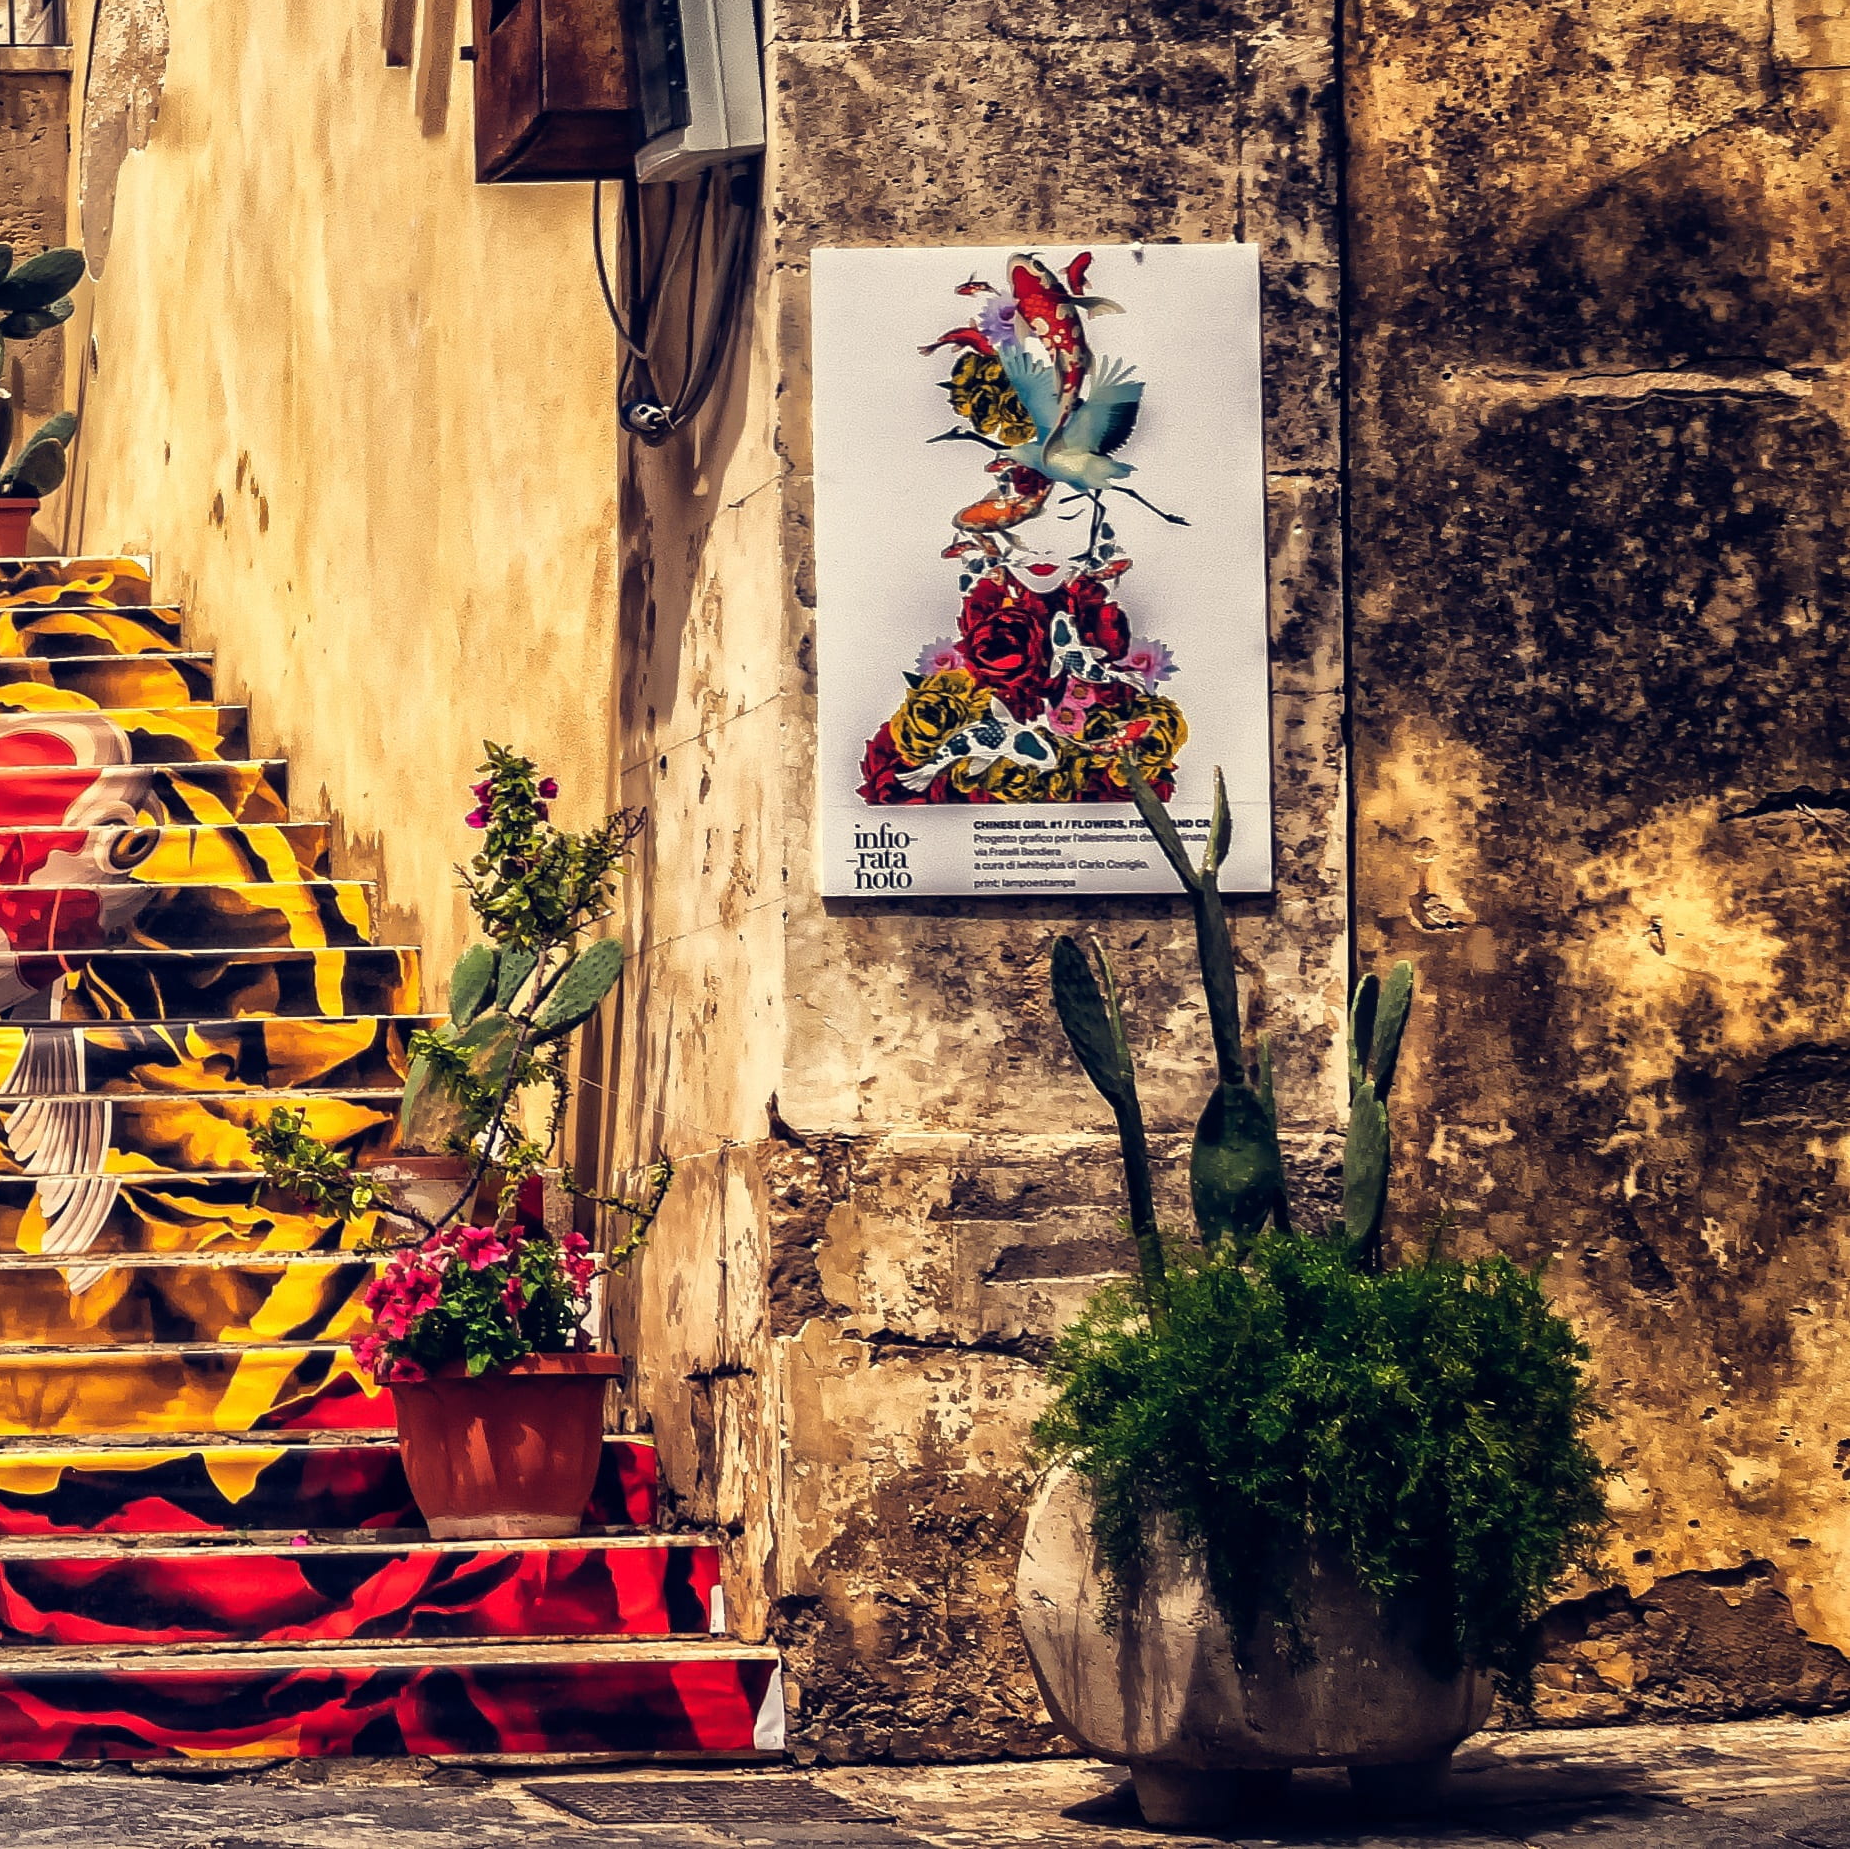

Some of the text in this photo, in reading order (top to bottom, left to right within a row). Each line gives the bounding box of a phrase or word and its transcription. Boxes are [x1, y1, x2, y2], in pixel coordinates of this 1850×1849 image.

[973, 820, 1021, 829] CHINESE
[1022, 820, 1048, 829] GIRL
[1072, 819, 1127, 829] FLOWERS,
[973, 834, 1017, 845] Progetto
[1018, 834, 1053, 845] grafico
[1054, 835, 1072, 845] per
[1073, 833, 1138, 843] l'allestimento
[973, 847, 1061, 856] via Fratelli Bandiera
[973, 862, 981, 870] a
[982, 862, 1004, 870] cura
[1006, 861, 1015, 870] di
[1078, 859, 1105, 869] Carlo
[854, 868, 913, 889] noto
